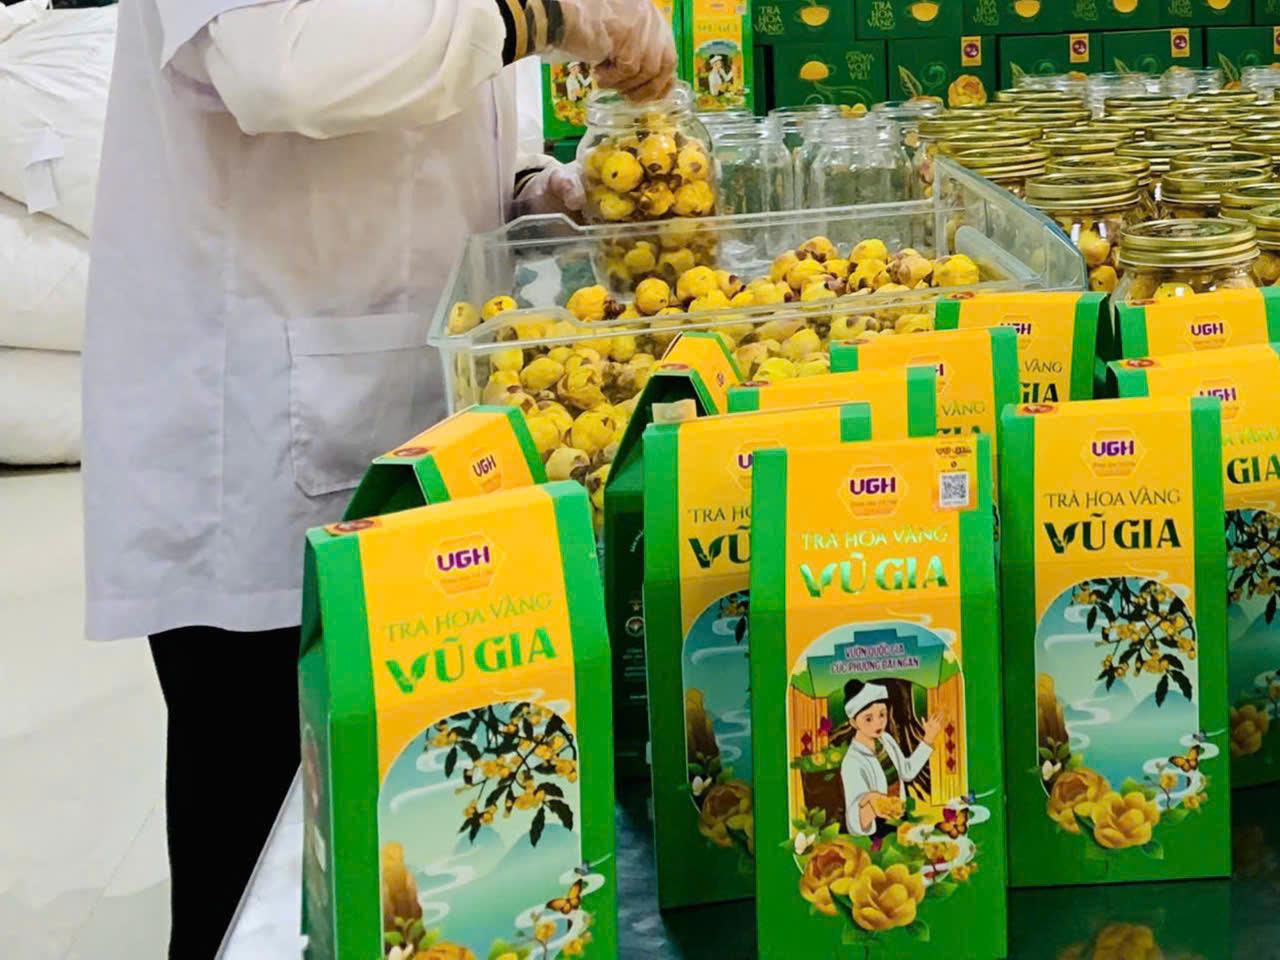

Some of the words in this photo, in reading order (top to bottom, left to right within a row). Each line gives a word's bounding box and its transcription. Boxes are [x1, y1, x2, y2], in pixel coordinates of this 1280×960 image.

[1092, 440, 1134, 456] UGH
[850, 476, 896, 495] UGH
[1086, 490, 1125, 510] HOA
[845, 527, 888, 548] HOA
[1043, 512, 1106, 554] VŨ
[1113, 517, 1182, 550] GIA
[437, 545, 490, 572] UGH
[875, 555, 949, 591] GIA
[435, 608, 485, 635] HOA
[474, 626, 558, 673] GIA
